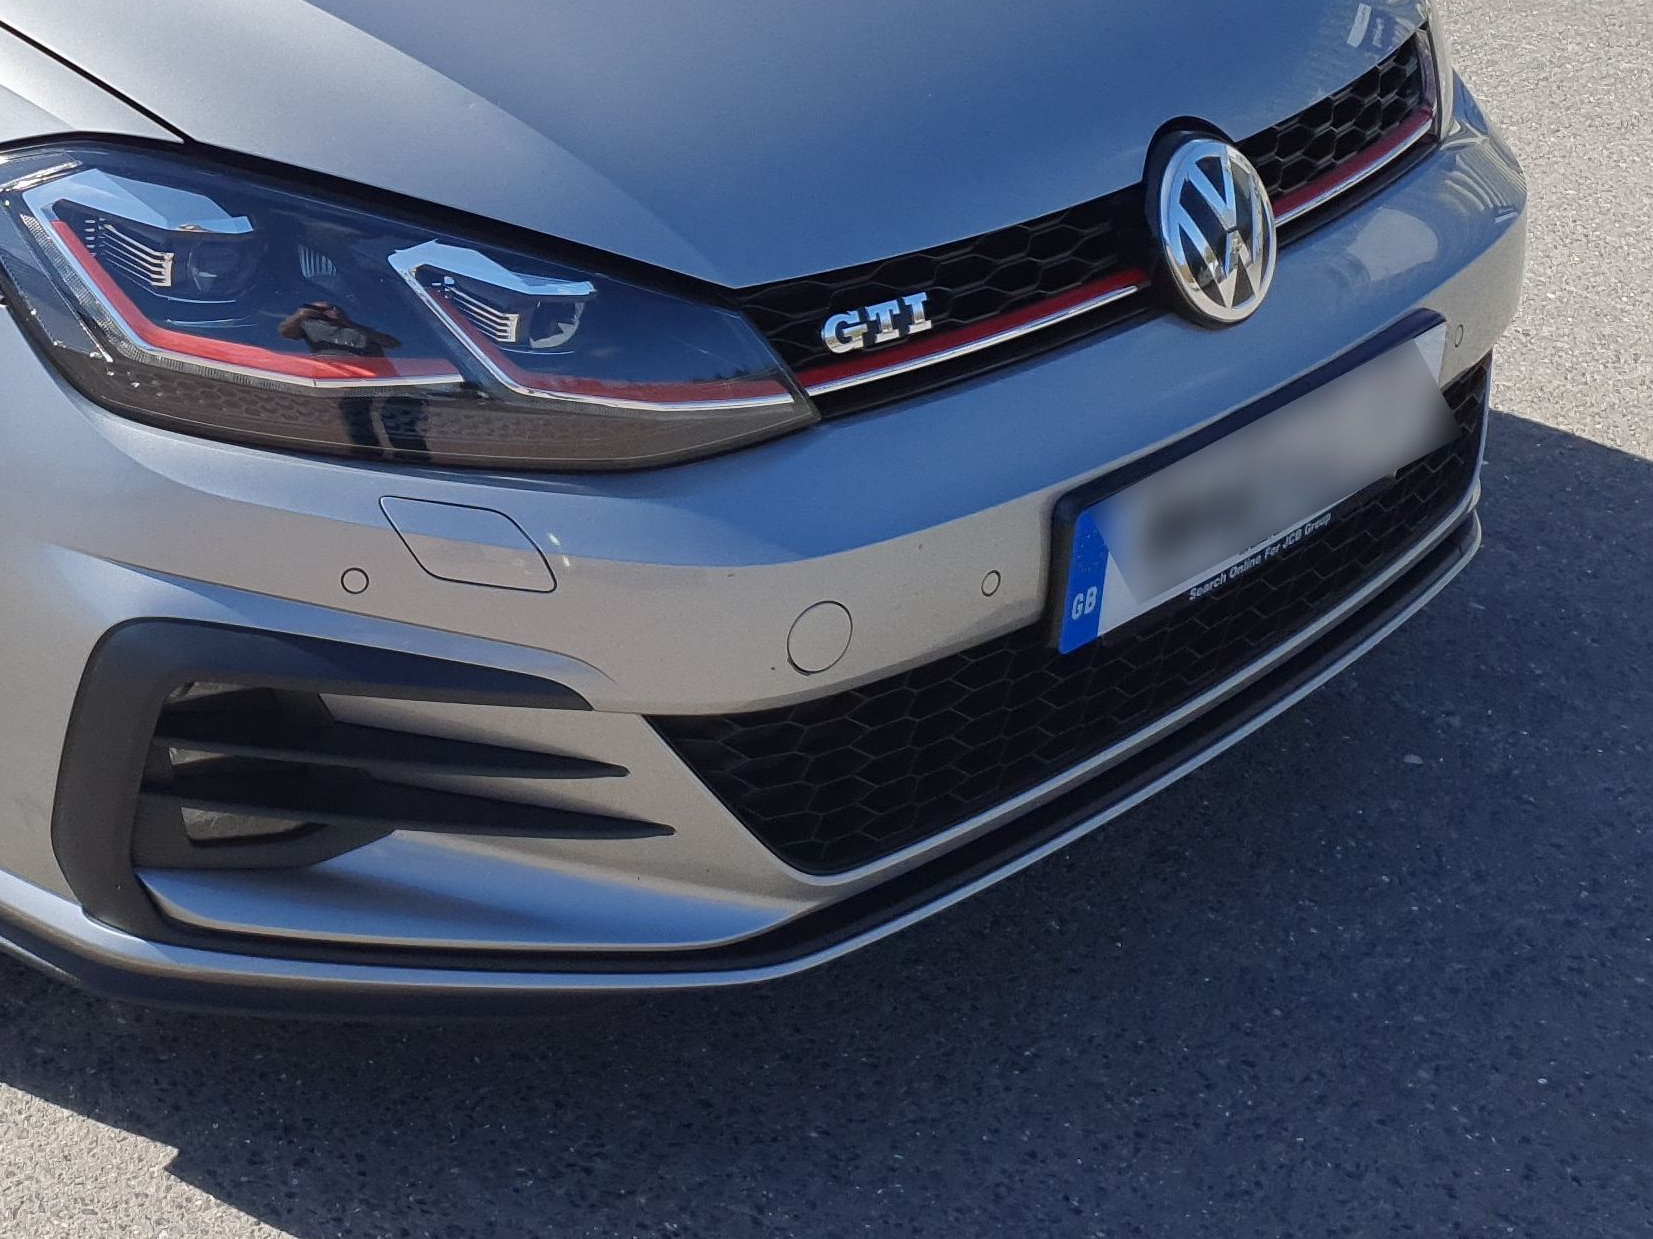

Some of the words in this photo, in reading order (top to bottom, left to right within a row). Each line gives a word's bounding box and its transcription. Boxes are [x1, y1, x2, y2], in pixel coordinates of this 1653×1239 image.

[820, 291, 933, 355] GTI
[1189, 572, 1227, 601] Search
[1229, 553, 1262, 580] Online
[1304, 512, 1332, 536] Group
[1071, 585, 1098, 620] GB
